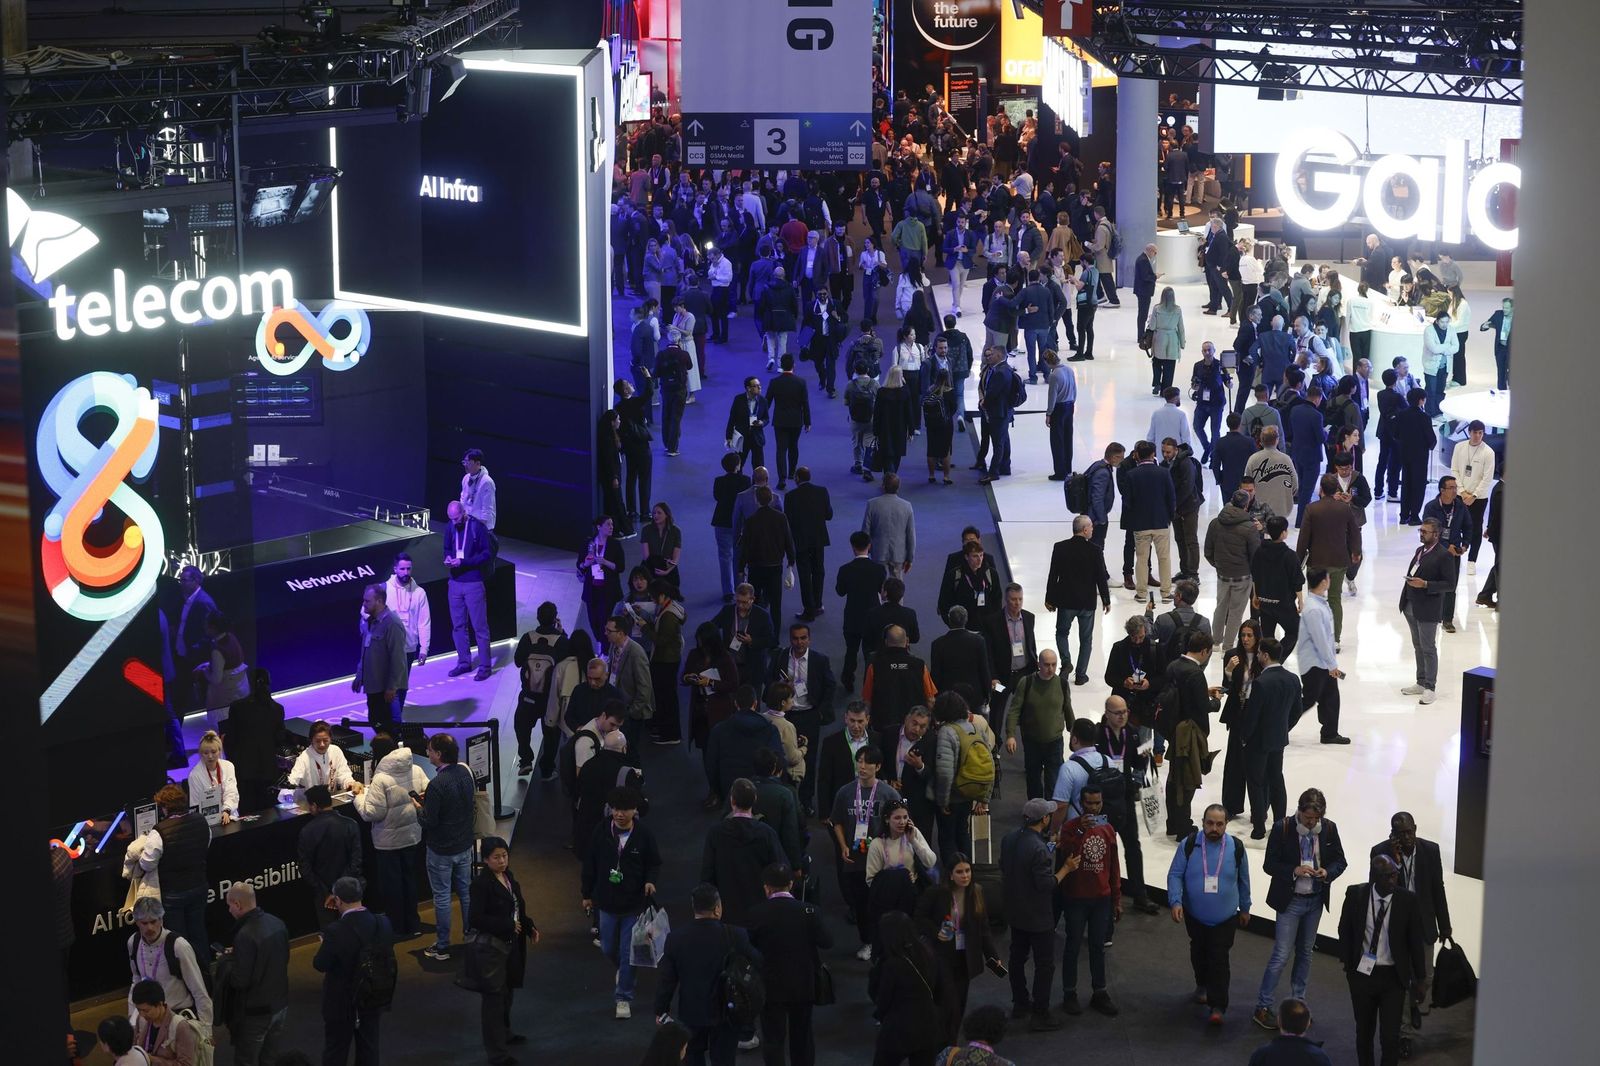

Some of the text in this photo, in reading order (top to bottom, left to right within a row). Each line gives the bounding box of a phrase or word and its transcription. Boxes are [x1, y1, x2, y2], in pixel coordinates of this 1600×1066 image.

[933, 1, 958, 14] the
[933, 15, 978, 28] future
[1004, 59, 1043, 77] oran
[766, 127, 787, 156] 3
[419, 174, 483, 203] AI Infra
[48, 267, 295, 342] telecom
[285, 564, 376, 592] Network AI
[219, 861, 302, 900] Psibili
[91, 906, 136, 936] AI fo
